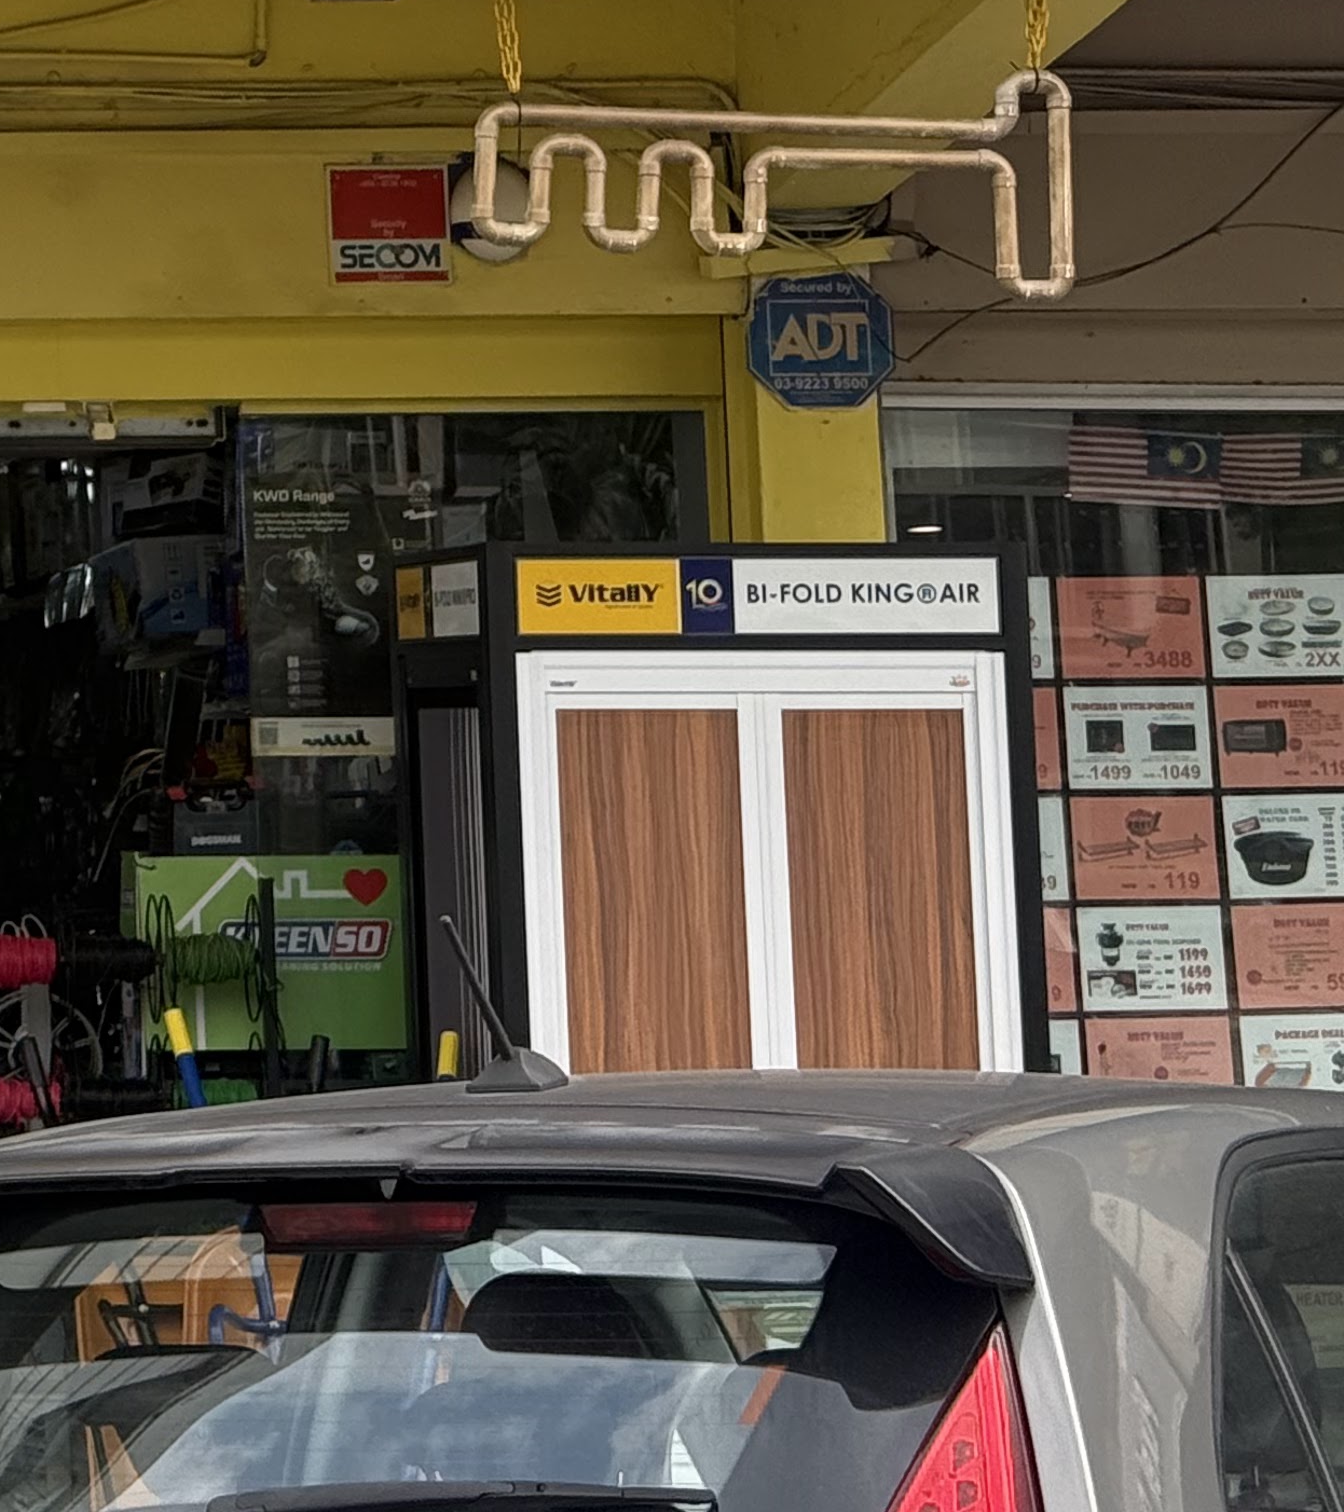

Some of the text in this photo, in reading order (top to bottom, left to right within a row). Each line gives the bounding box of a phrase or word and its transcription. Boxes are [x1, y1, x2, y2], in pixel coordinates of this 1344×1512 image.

[339, 242, 442, 269] SECOM
[780, 281, 853, 296] Secured by
[771, 311, 870, 361] ADT
[773, 377, 869, 390] 03-9223 9500
[252, 489, 336, 505] KWD Range
[746, 582, 843, 604] BI-FOLD
[1144, 650, 1194, 669] 3488
[1304, 651, 1342, 668] 2XX
[1090, 764, 1132, 780] 1499
[1160, 763, 1202, 780] 1049
[1163, 870, 1201, 889] 119
